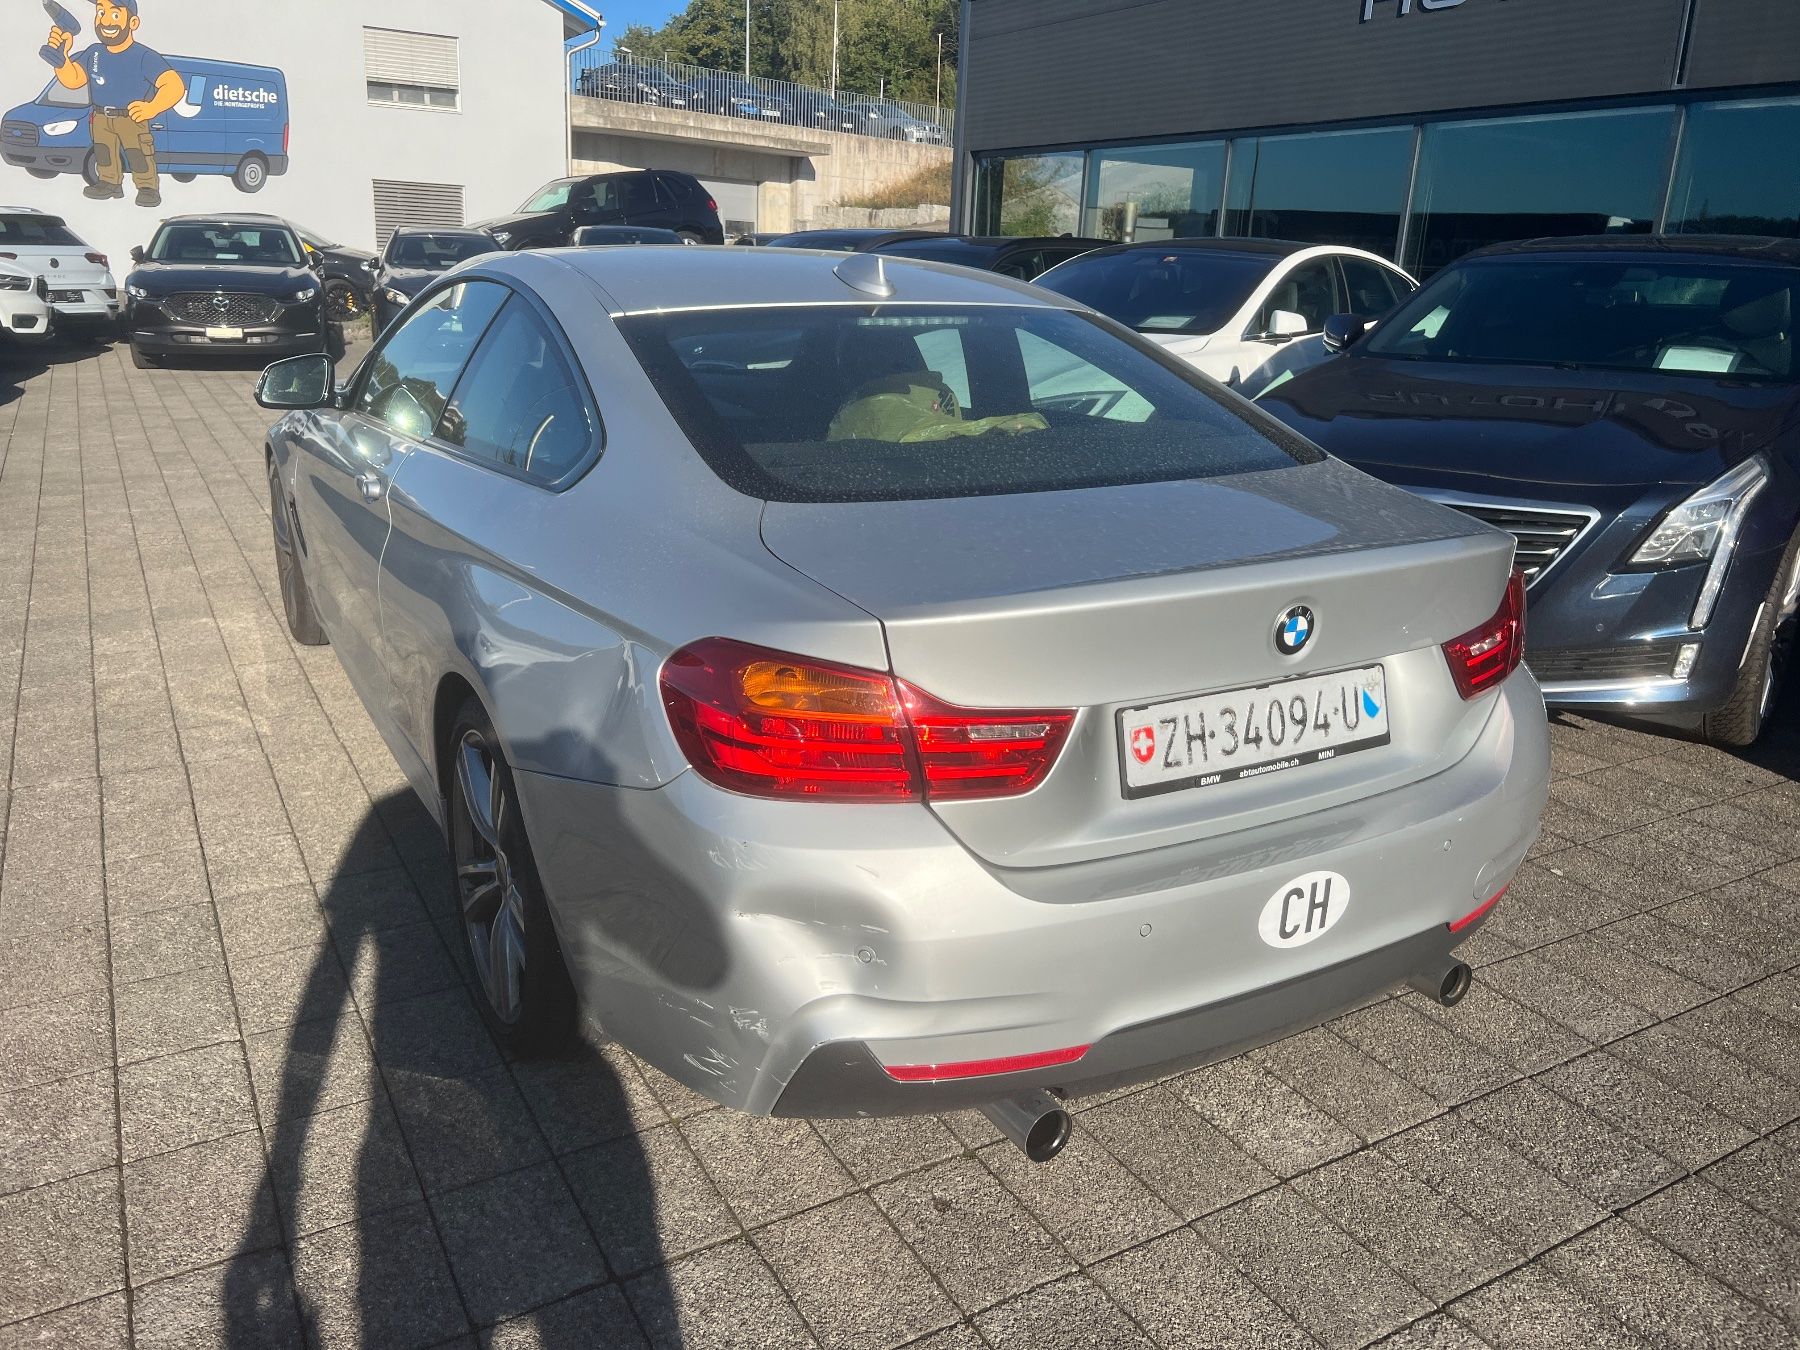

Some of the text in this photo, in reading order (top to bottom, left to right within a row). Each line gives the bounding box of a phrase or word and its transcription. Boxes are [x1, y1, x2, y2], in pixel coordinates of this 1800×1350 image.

[213, 84, 278, 104] dietsche
[1200, 749, 1335, 786] BMW abtautomobile.ch MINI
[1278, 877, 1332, 940] CH
